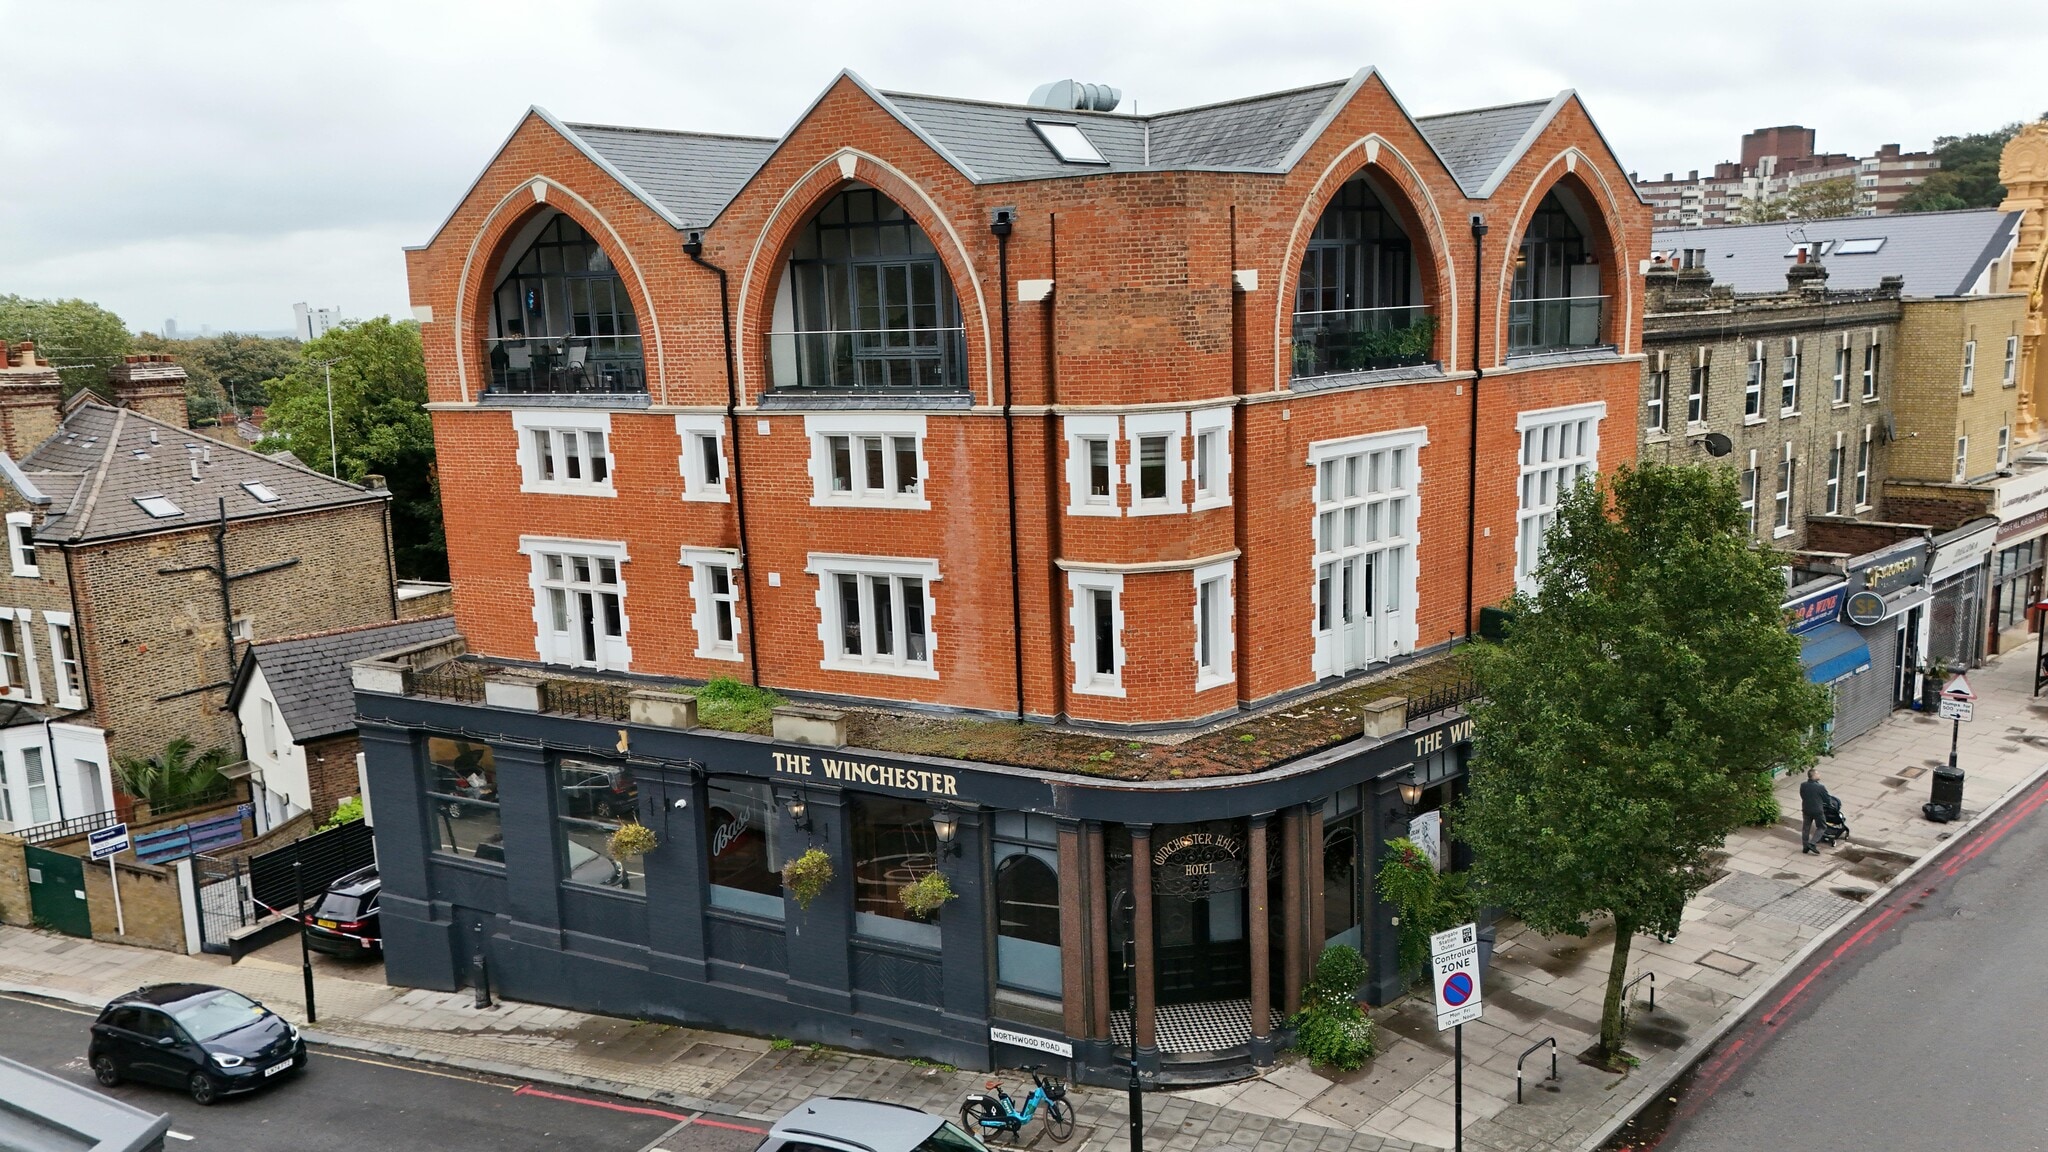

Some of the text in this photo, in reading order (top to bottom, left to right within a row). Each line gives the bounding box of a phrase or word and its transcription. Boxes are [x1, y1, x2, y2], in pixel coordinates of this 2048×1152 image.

[1816, 595, 1838, 613] WINE
[1855, 599, 1877, 615] SF
[1414, 730, 1443, 757] THE
[772, 752, 958, 796] THE WINCHESTER
[713, 805, 750, 857] Bass
[1153, 833, 1240, 866] WINCHESTER HALL
[1185, 863, 1216, 876] HOTEL
[1436, 931, 1458, 941] Highgate
[1439, 937, 1457, 946] Station
[1435, 946, 1476, 965] Controlled
[1441, 943, 1455, 951] Outer
[1441, 957, 1470, 974] ZONE
[993, 1031, 1038, 1047] NORTHWOOD
[1040, 1041, 1060, 1052] ROAD
